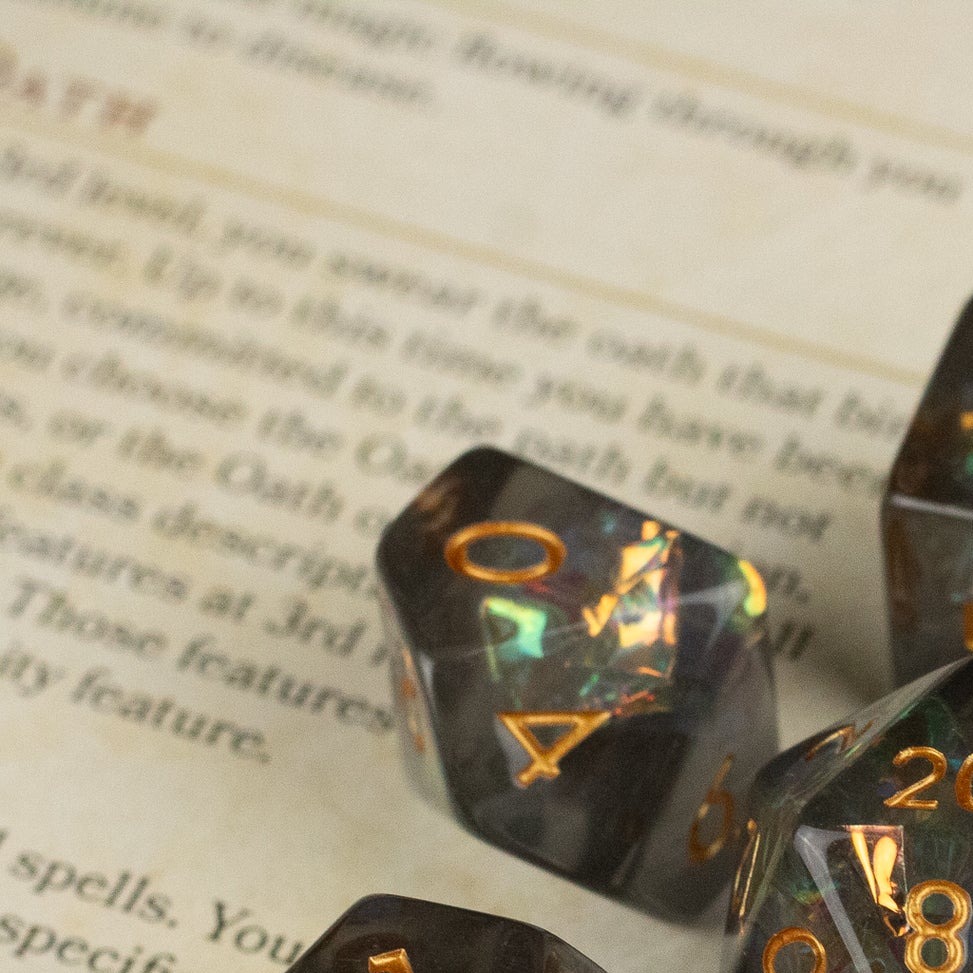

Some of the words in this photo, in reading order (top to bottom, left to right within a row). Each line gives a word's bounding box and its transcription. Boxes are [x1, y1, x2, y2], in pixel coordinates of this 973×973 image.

[5, 577, 170, 660] Those
[176, 634, 400, 737] features
[68, 666, 272, 765] feature.
[497, 710, 613, 789] 4
[8, 848, 182, 929] spells.
[206, 900, 303, 966] You
